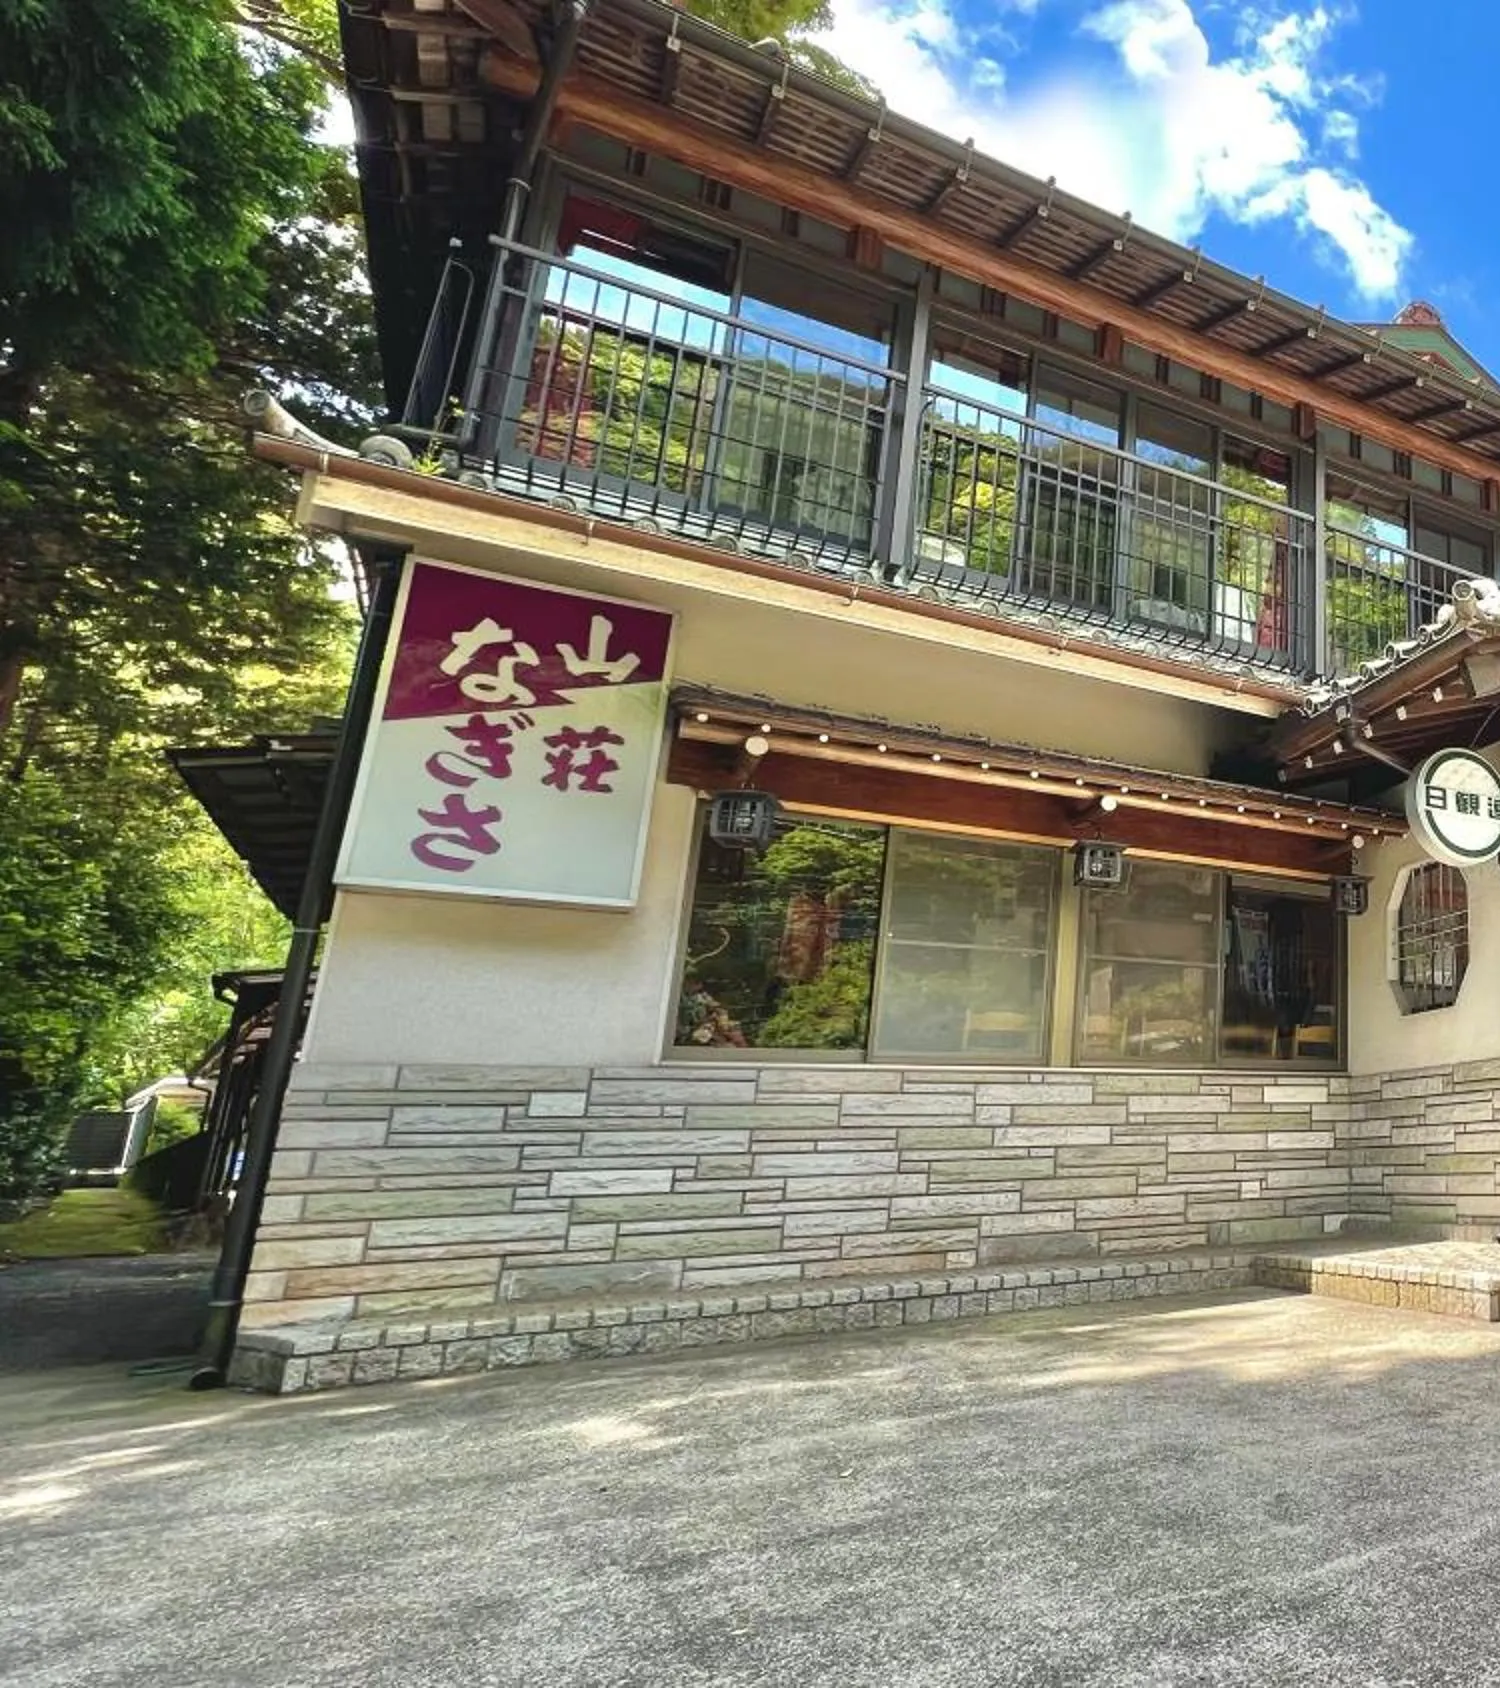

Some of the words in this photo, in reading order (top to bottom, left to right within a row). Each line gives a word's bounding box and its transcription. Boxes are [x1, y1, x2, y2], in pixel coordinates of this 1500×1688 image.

[410, 617, 540, 873] なぎさ
[541, 614, 641, 794] 山荘
